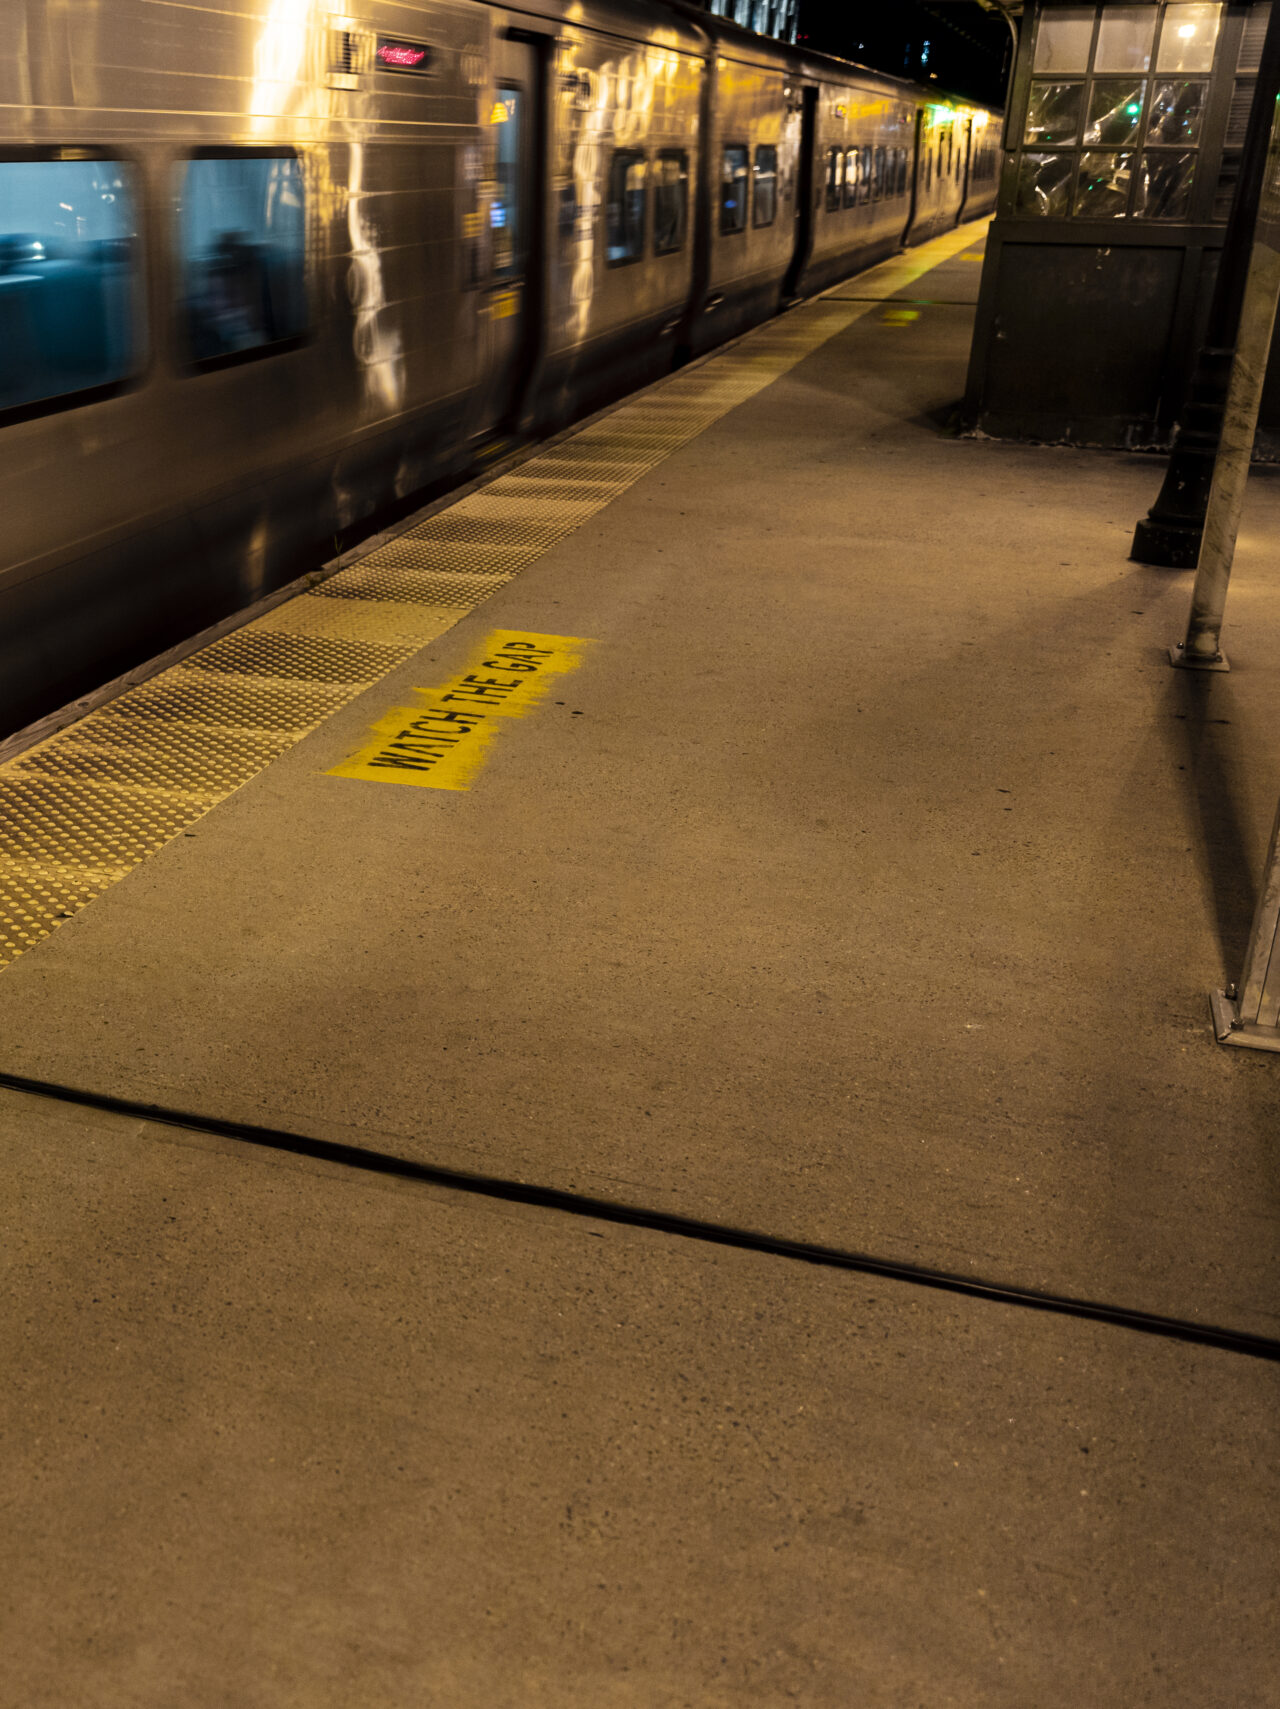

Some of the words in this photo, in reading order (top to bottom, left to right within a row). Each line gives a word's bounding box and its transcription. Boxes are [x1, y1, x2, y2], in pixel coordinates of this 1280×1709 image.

[367, 708, 486, 772] WATCH
[441, 674, 523, 705] THE
[482, 641, 554, 673] GAP
